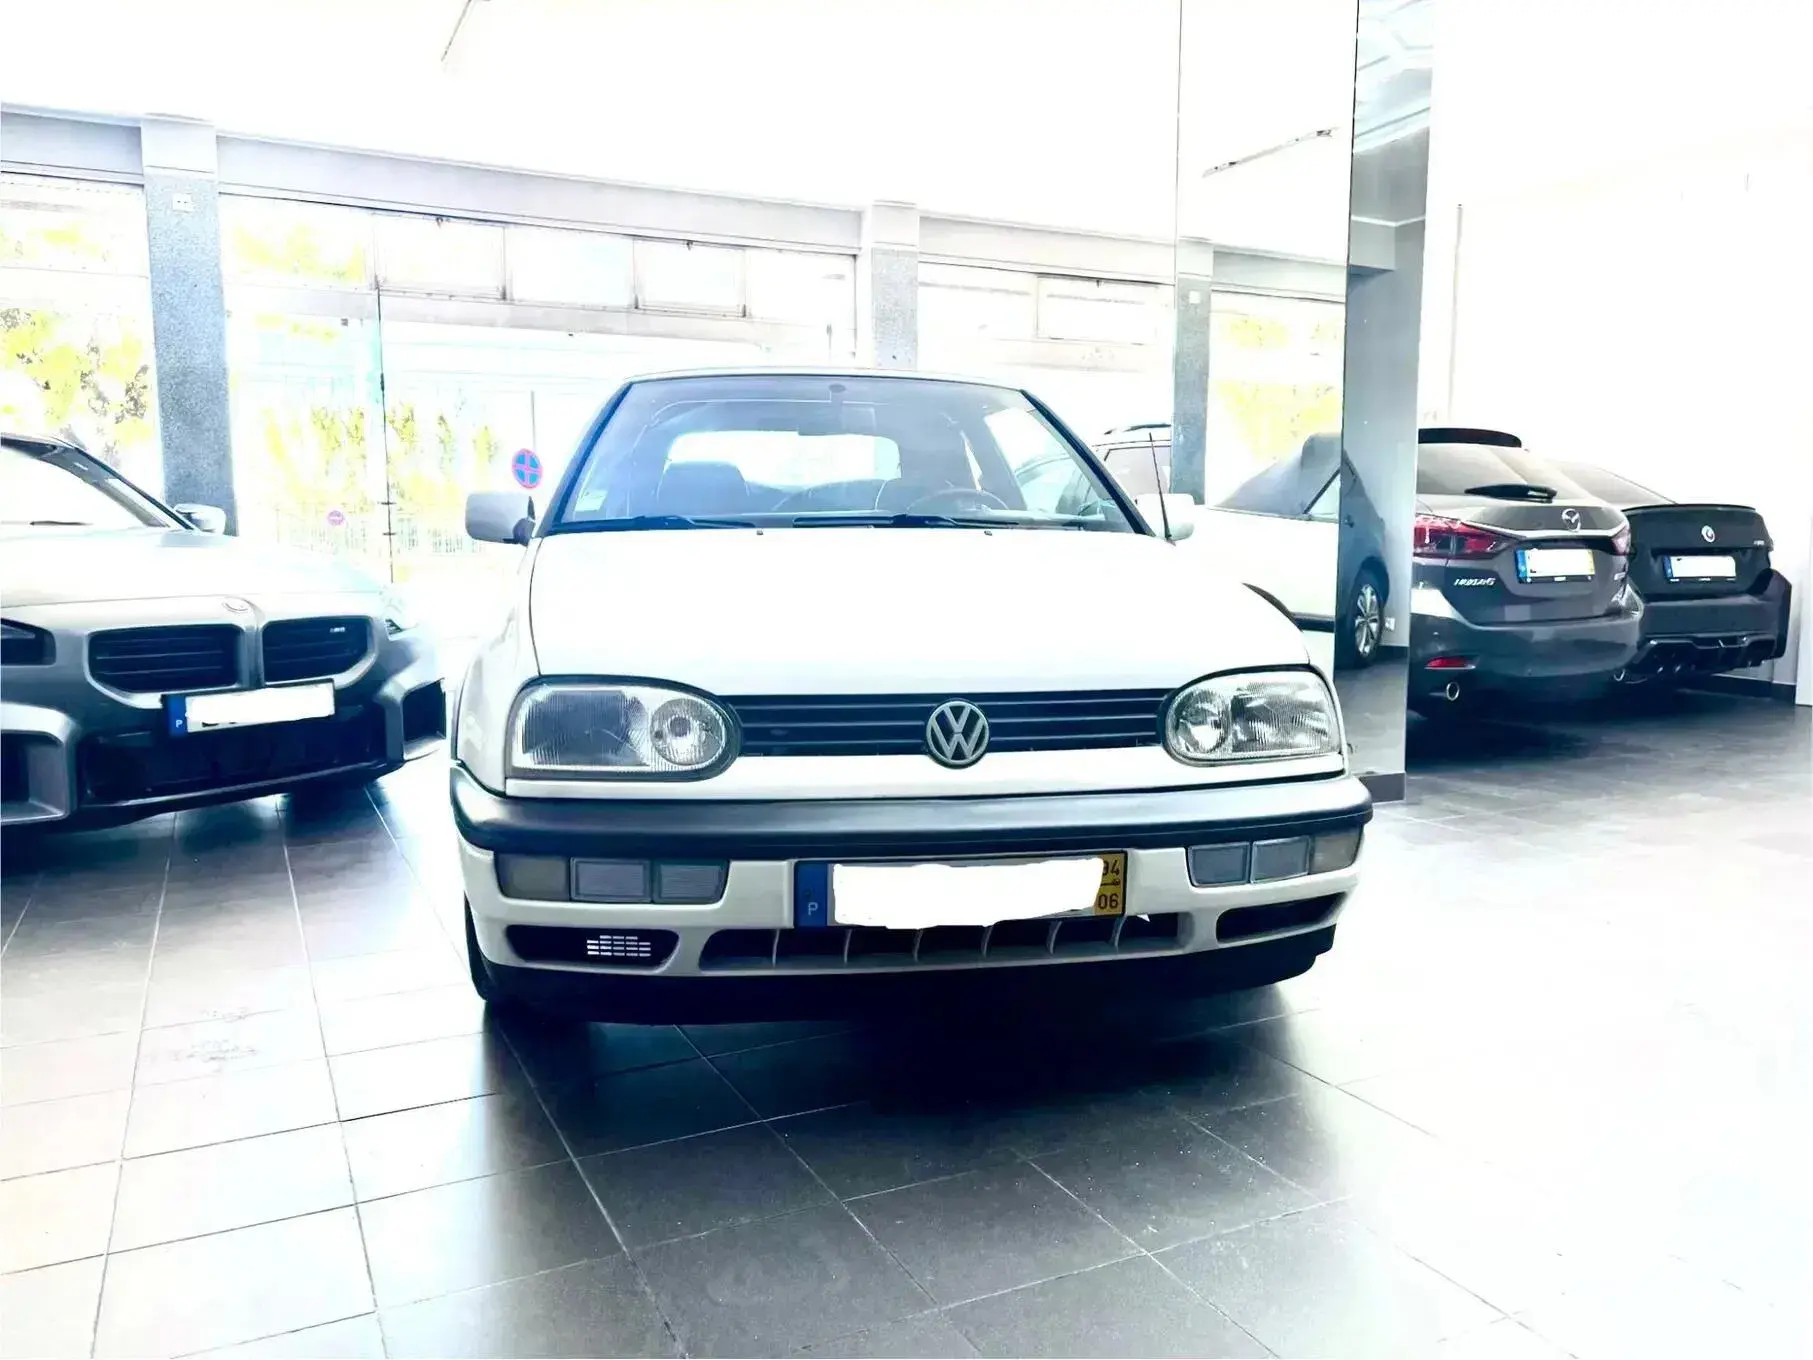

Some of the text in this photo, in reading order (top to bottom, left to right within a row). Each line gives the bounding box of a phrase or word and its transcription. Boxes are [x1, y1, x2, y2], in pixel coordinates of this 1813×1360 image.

[175, 719, 183, 728] P
[808, 901, 818, 916] P
[1098, 893, 1119, 909] 06
